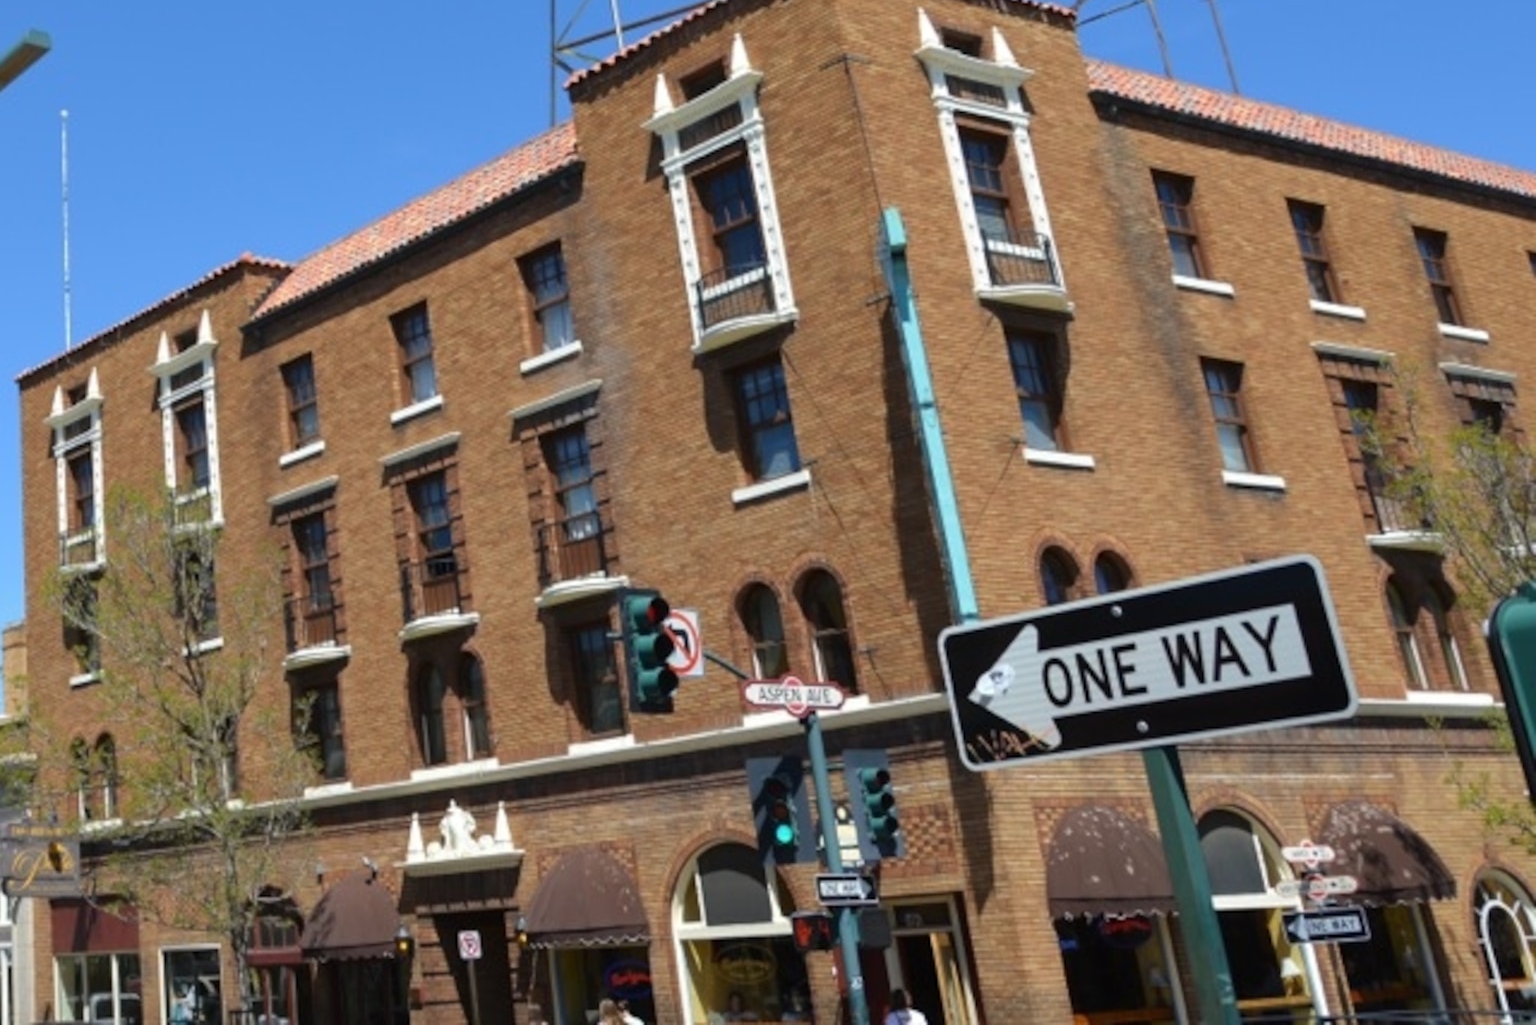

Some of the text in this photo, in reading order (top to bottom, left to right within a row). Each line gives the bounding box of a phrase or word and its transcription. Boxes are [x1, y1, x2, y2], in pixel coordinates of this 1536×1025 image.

[1042, 614, 1280, 708] ONE WAY
[758, 687, 833, 704] ASPEN AVE
